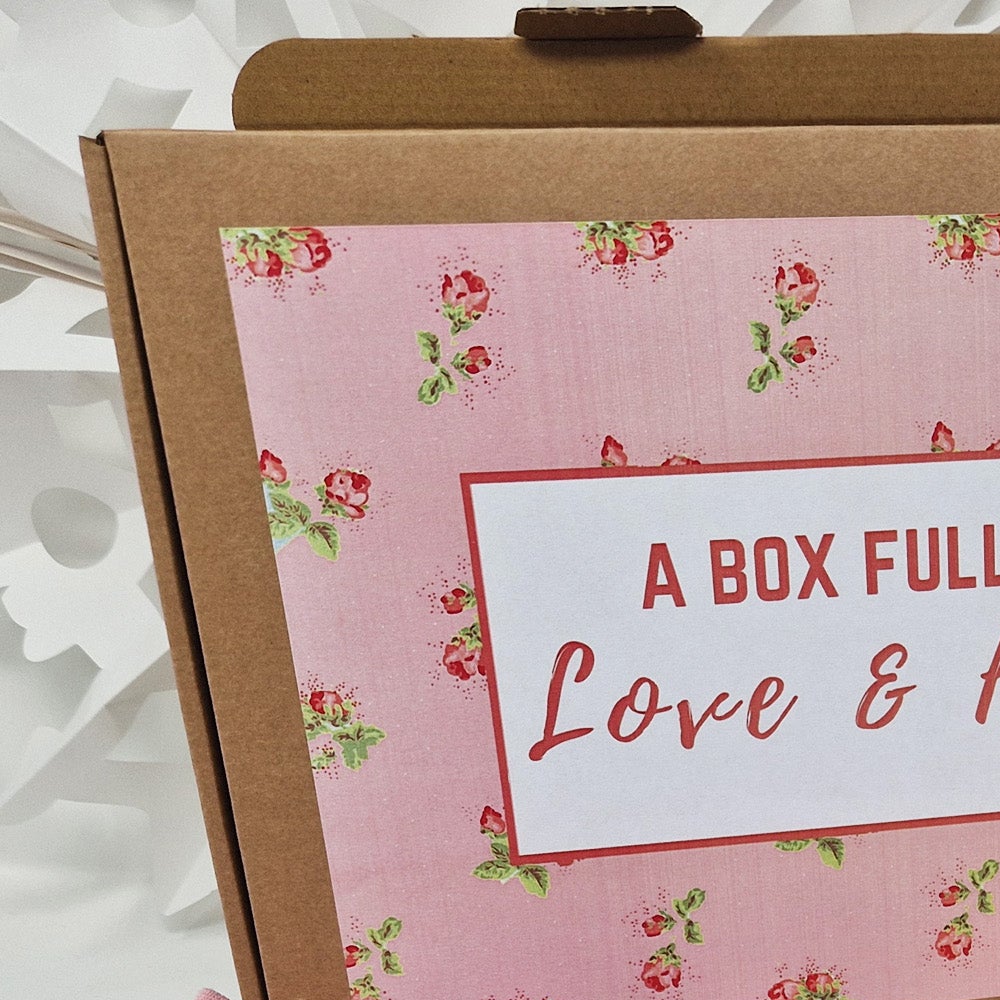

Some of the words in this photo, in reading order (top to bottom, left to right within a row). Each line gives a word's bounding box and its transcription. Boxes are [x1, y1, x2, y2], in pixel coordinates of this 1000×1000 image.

[642, 542, 688, 610] A
[709, 533, 839, 605] BOX
[528, 640, 799, 762] Love
[855, 642, 917, 730] &
